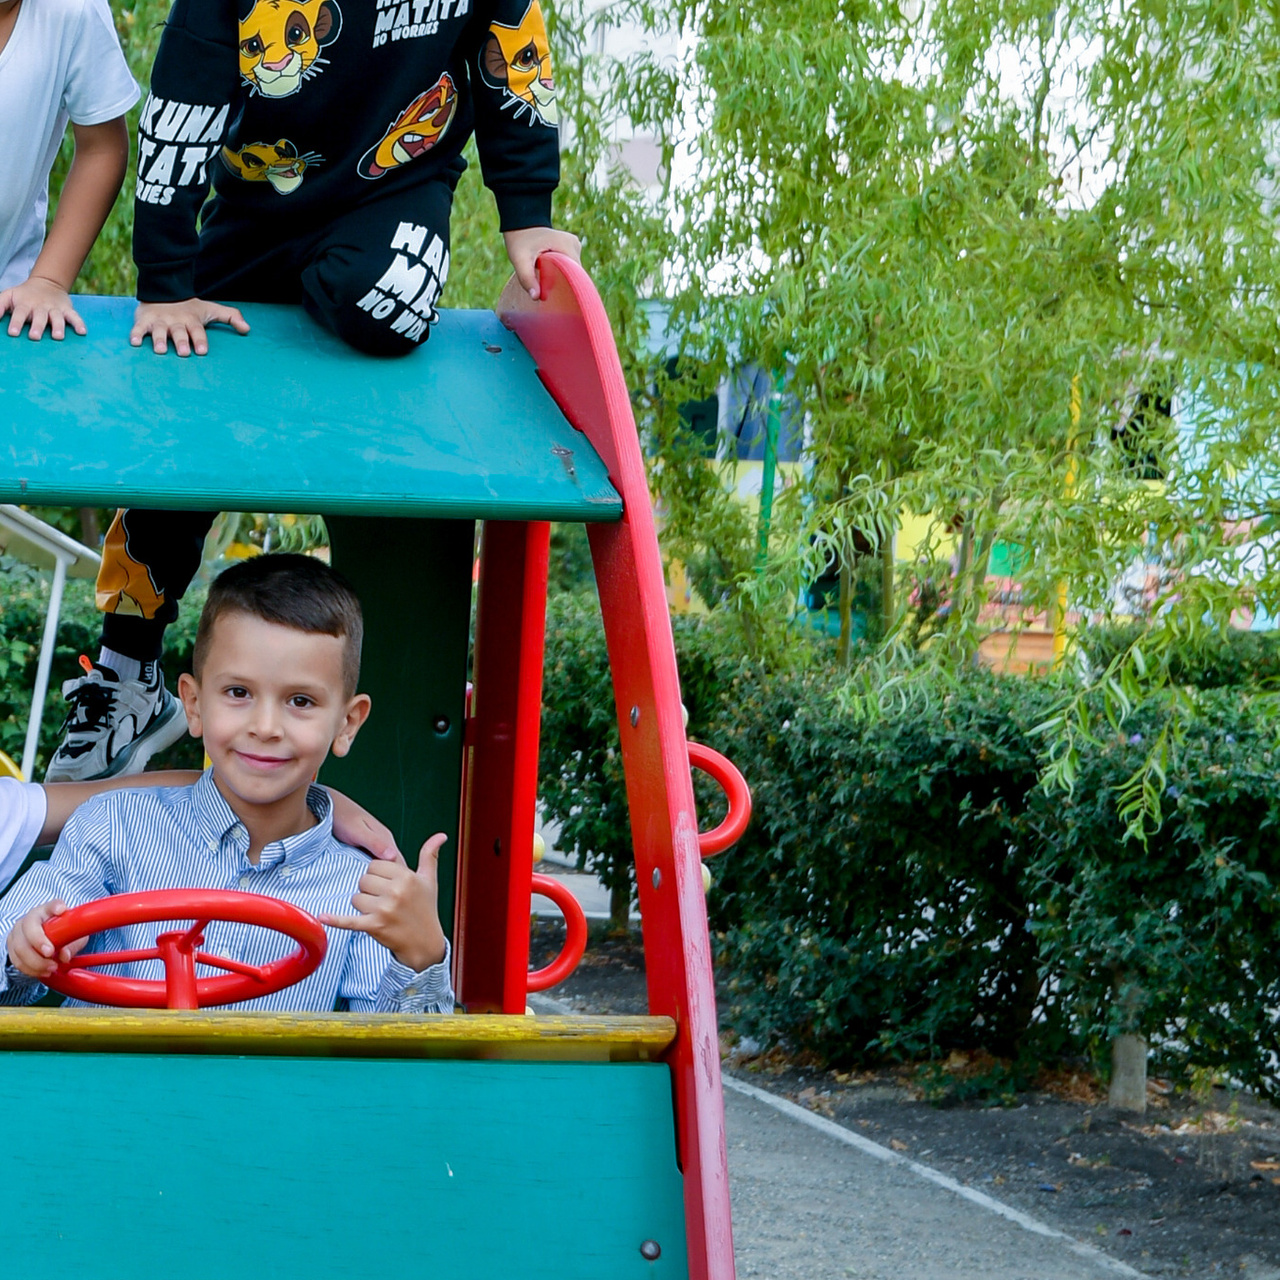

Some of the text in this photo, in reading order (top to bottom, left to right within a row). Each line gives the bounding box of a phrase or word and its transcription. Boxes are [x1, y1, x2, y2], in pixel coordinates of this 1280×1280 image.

[372, 21, 440, 49] NO WORRIES
[390, 221, 450, 288] HA
[355, 288, 396, 320] NO
[375, 252, 439, 325] MA
